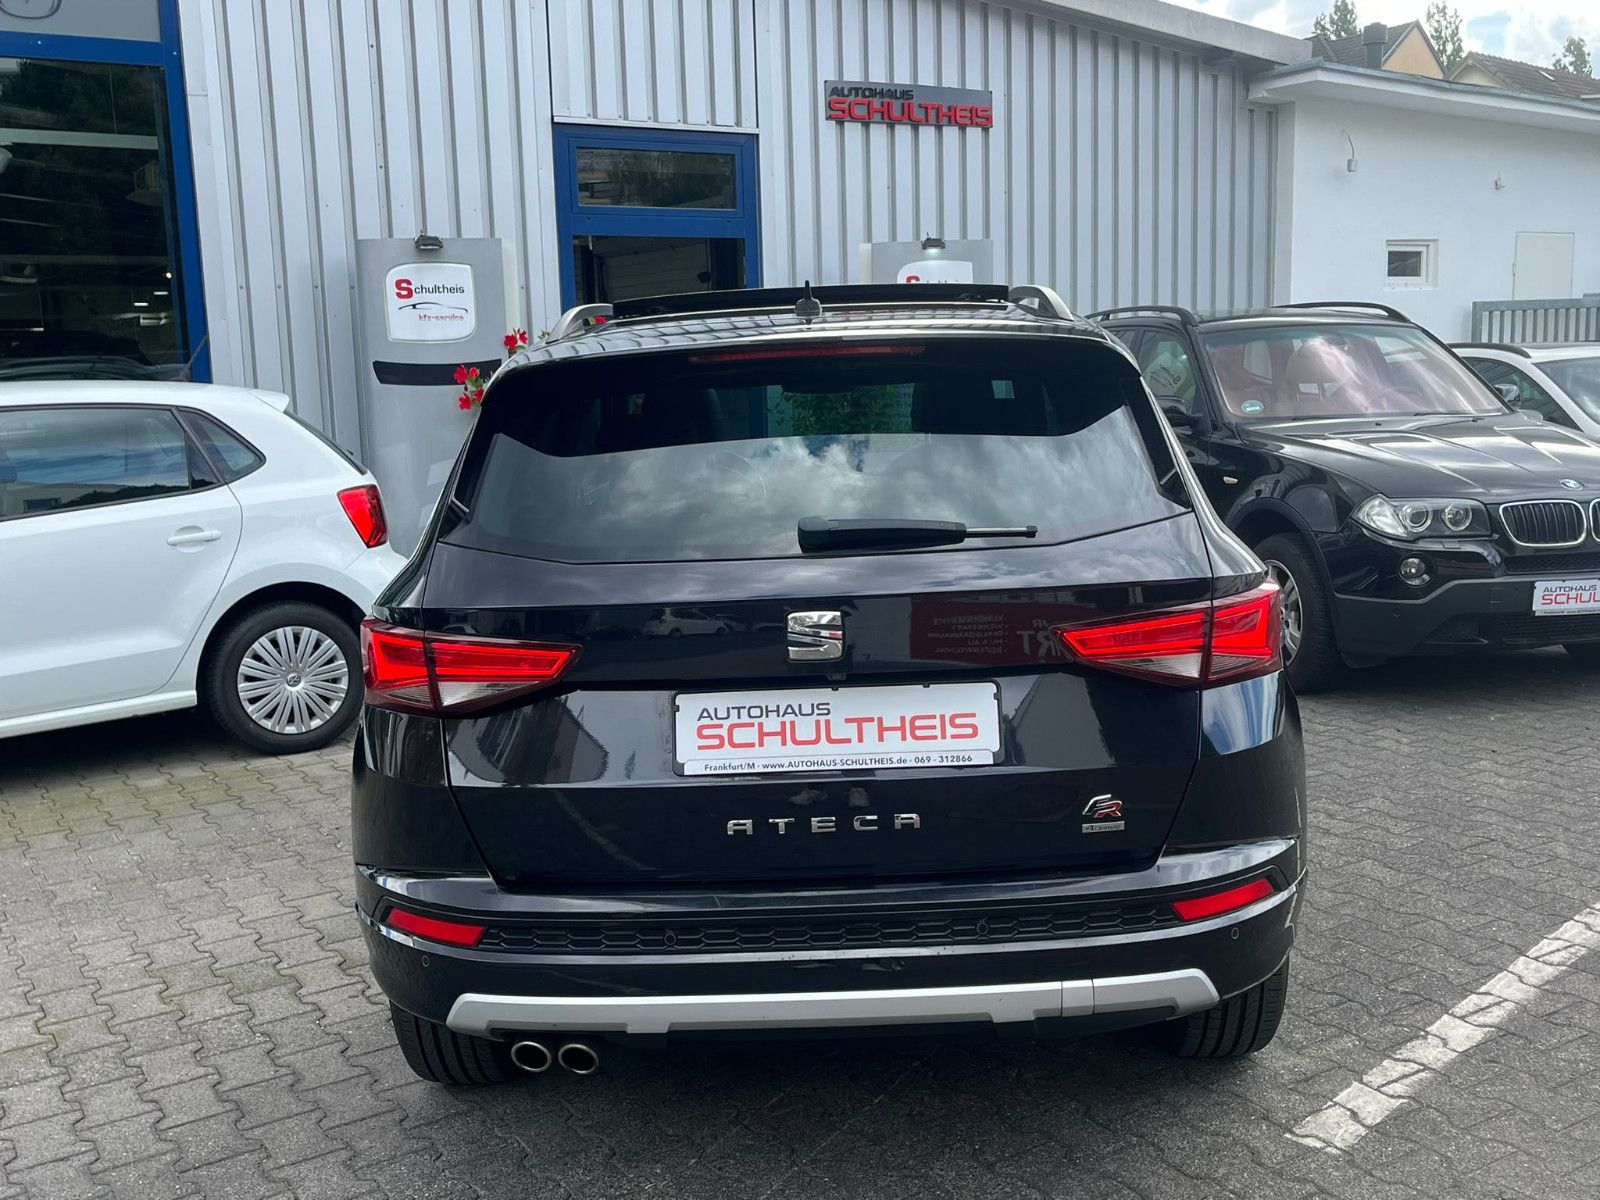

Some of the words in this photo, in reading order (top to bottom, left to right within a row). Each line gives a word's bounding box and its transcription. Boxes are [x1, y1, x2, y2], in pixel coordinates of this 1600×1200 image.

[829, 86, 914, 100] AUTOHAUS
[829, 97, 992, 126] SCHULTHEIS
[395, 278, 465, 299] Schultheis
[1542, 585, 1597, 593] AUTOHAUS
[697, 703, 831, 721] AUTOHAUS
[696, 712, 979, 750] SCHULTHEIS
[704, 762, 756, 772] Frankfurt/M
[762, 757, 908, 770] www.AUTOHAUS-SCHULTHEIS.de
[914, 756, 931, 764] 069
[938, 755, 973, 763] 312866
[1082, 794, 1123, 818] FR
[727, 813, 921, 835] ATECA
